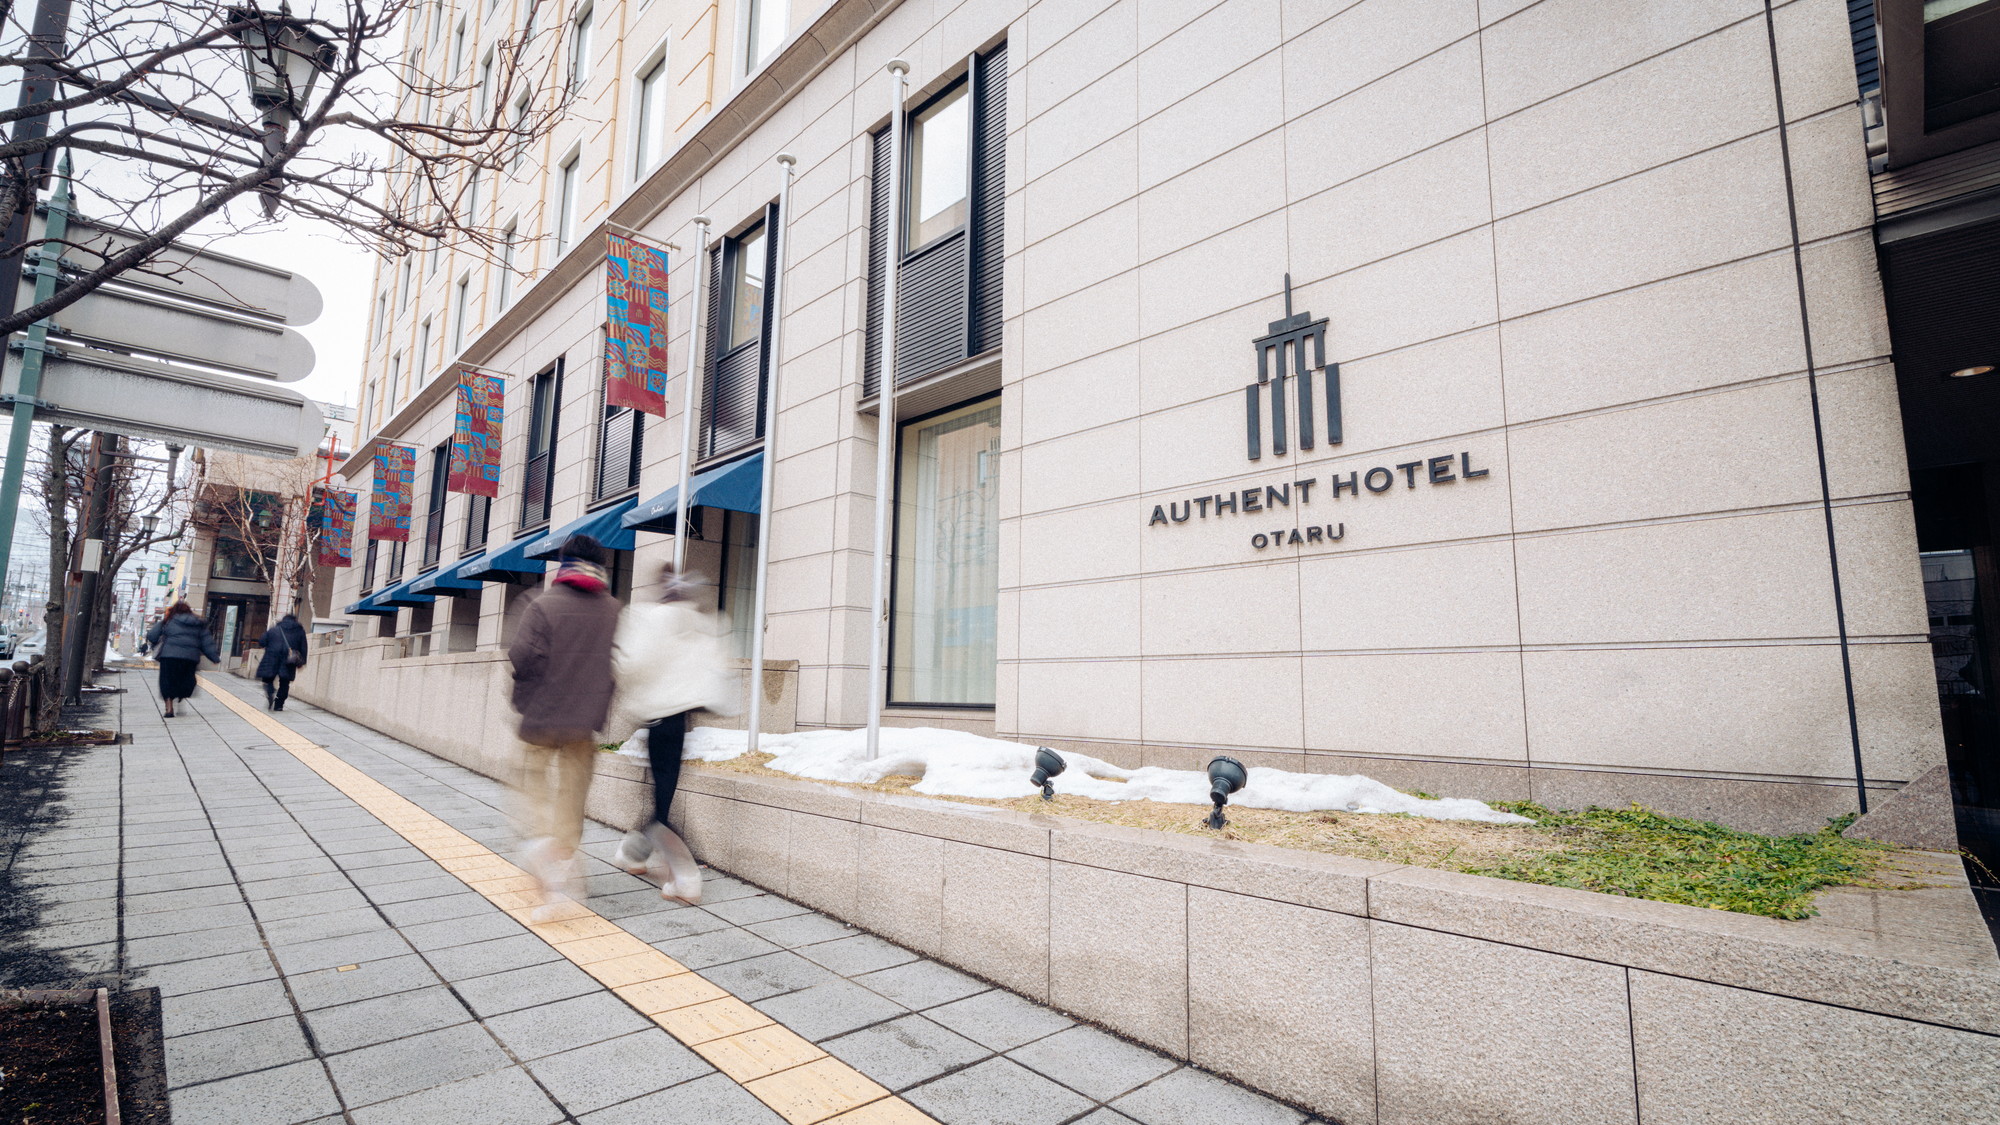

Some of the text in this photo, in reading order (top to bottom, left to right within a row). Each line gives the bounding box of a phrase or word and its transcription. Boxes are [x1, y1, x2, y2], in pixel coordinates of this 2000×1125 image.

[1149, 452, 1490, 527] AUTHENT HOTEL
[1251, 523, 1345, 550] OTARU
